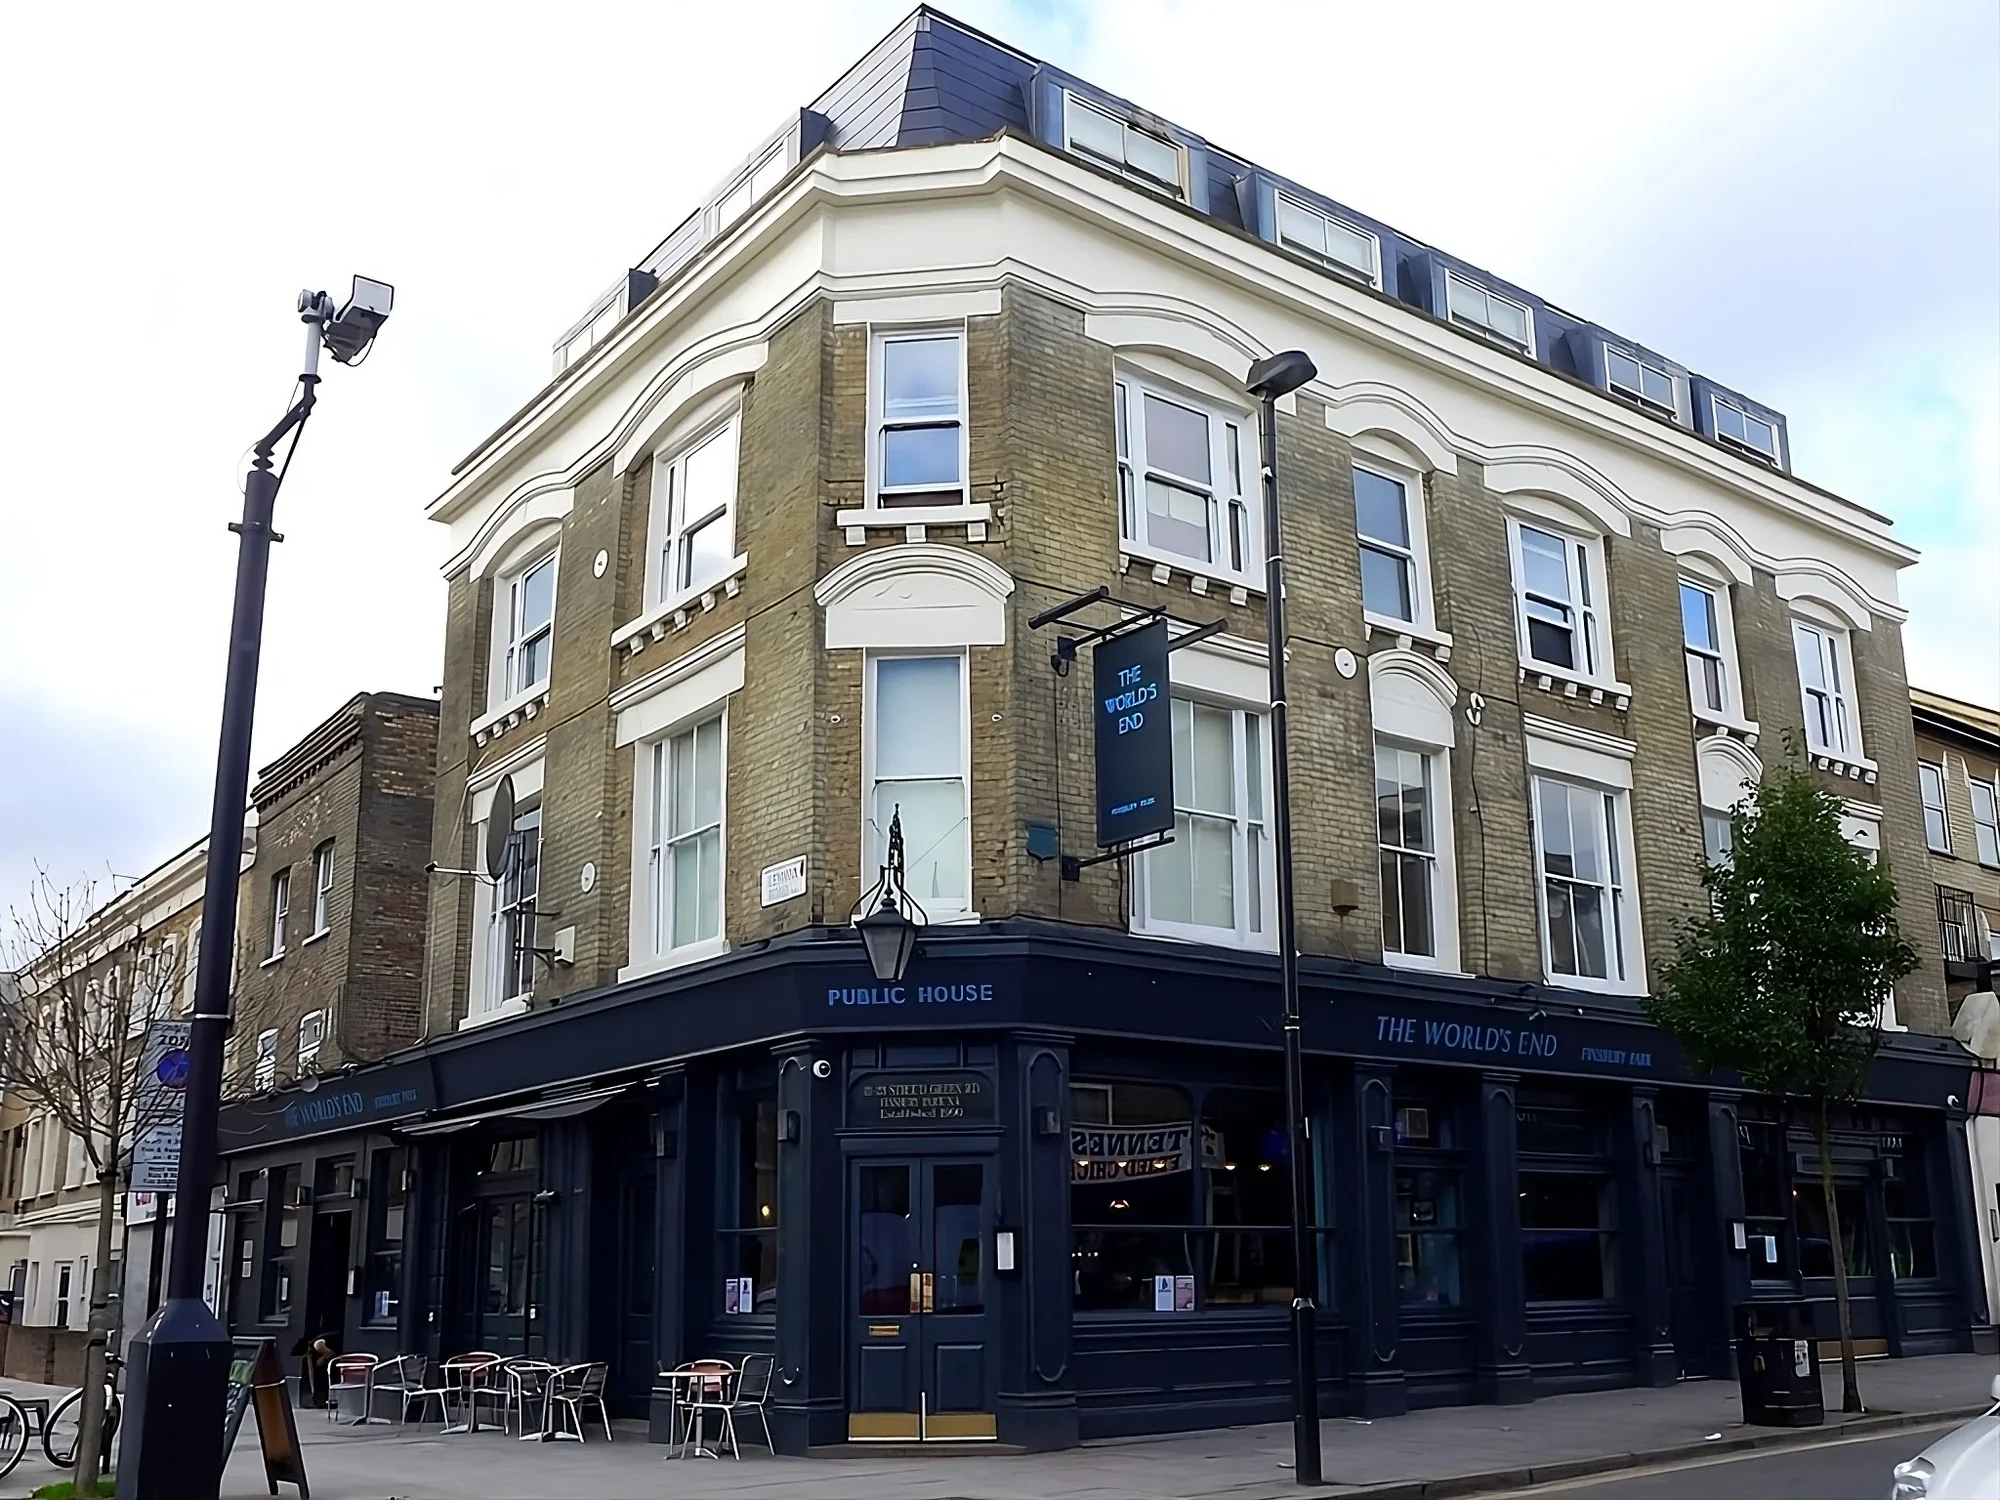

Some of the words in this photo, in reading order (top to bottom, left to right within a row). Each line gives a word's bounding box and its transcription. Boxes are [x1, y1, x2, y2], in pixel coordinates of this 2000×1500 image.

[1118, 664, 1142, 687] THE
[1118, 712, 1144, 735] END
[828, 987, 906, 1006] PUBLIC
[918, 984, 993, 1003] HOUSE
[1377, 1015, 1417, 1043] THE
[1425, 1020, 1512, 1053] WORLD'S
[1518, 1031, 1558, 1057] END
[342, 1092, 363, 1115] END
